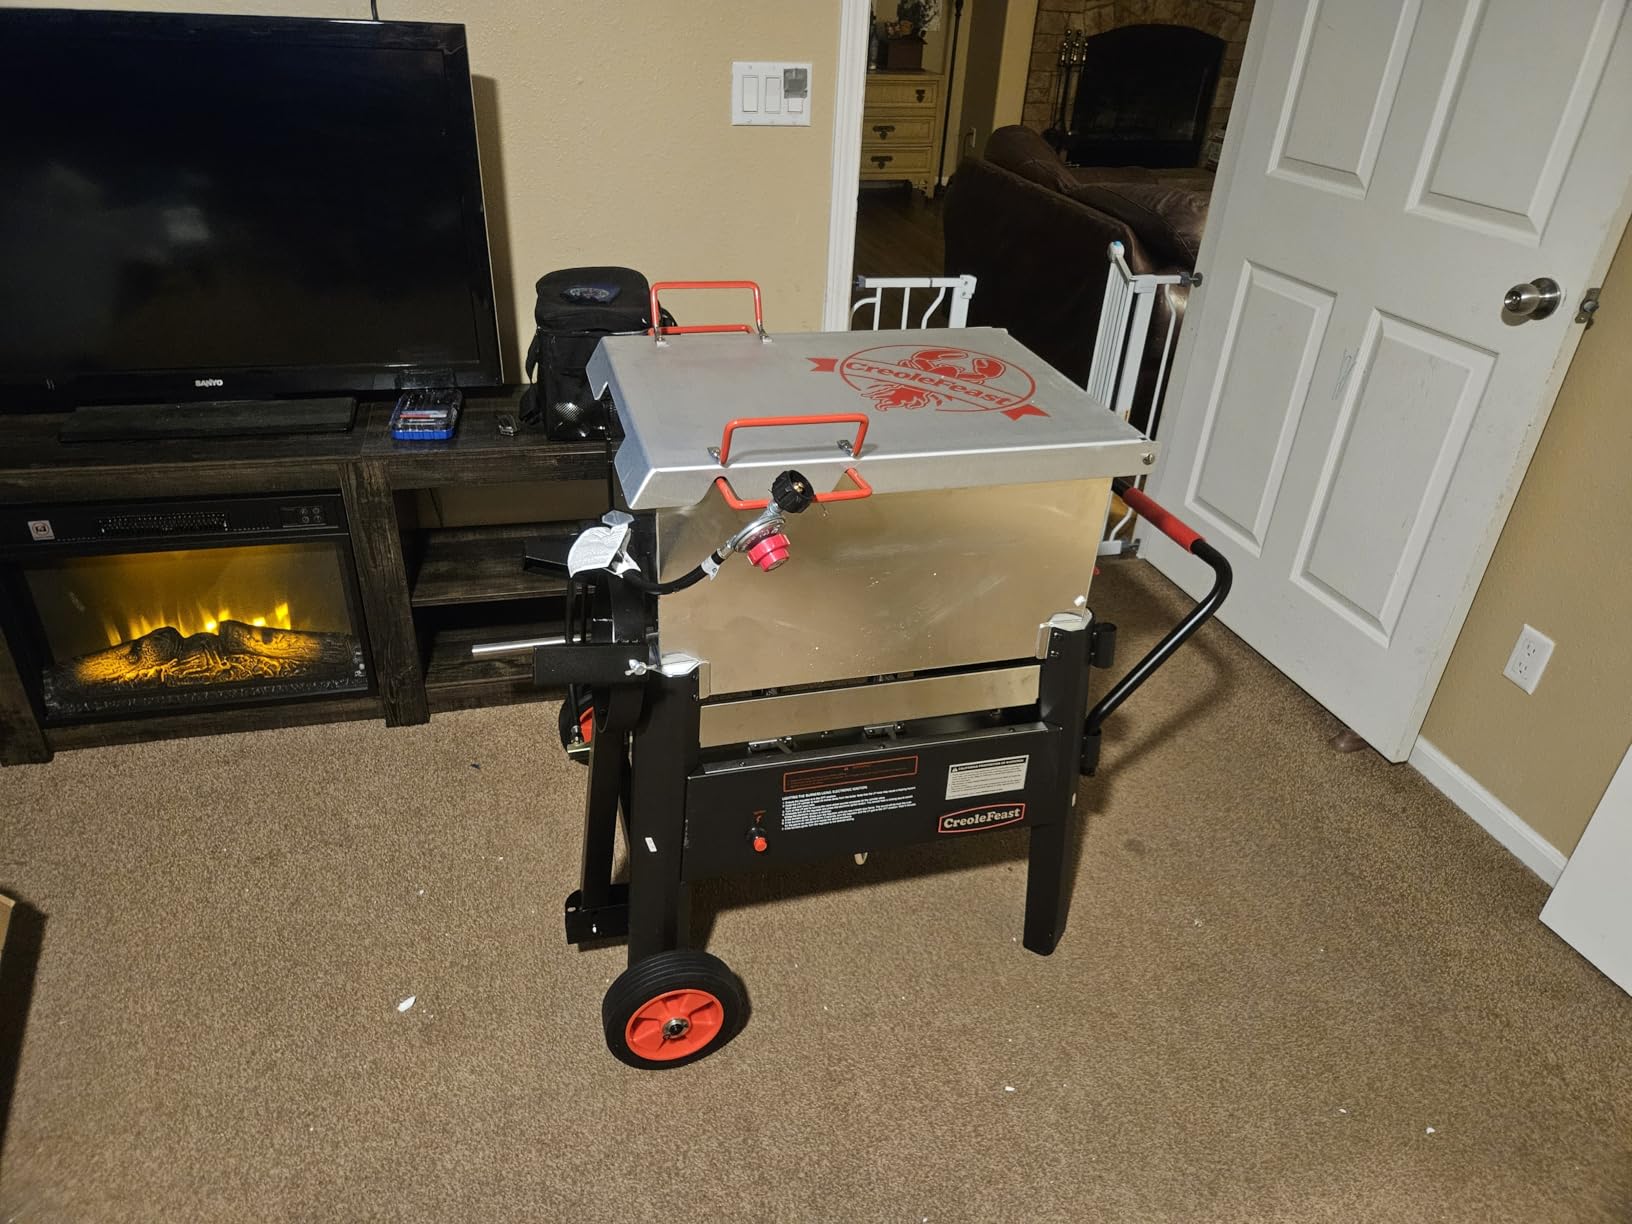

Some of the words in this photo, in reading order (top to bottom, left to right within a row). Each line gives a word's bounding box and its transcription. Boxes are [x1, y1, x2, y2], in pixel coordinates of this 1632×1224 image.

[195, 378, 223, 387] SANYO
[846, 362, 1012, 405] CreoleFeast
[944, 808, 1021, 828] CreoleFeast
